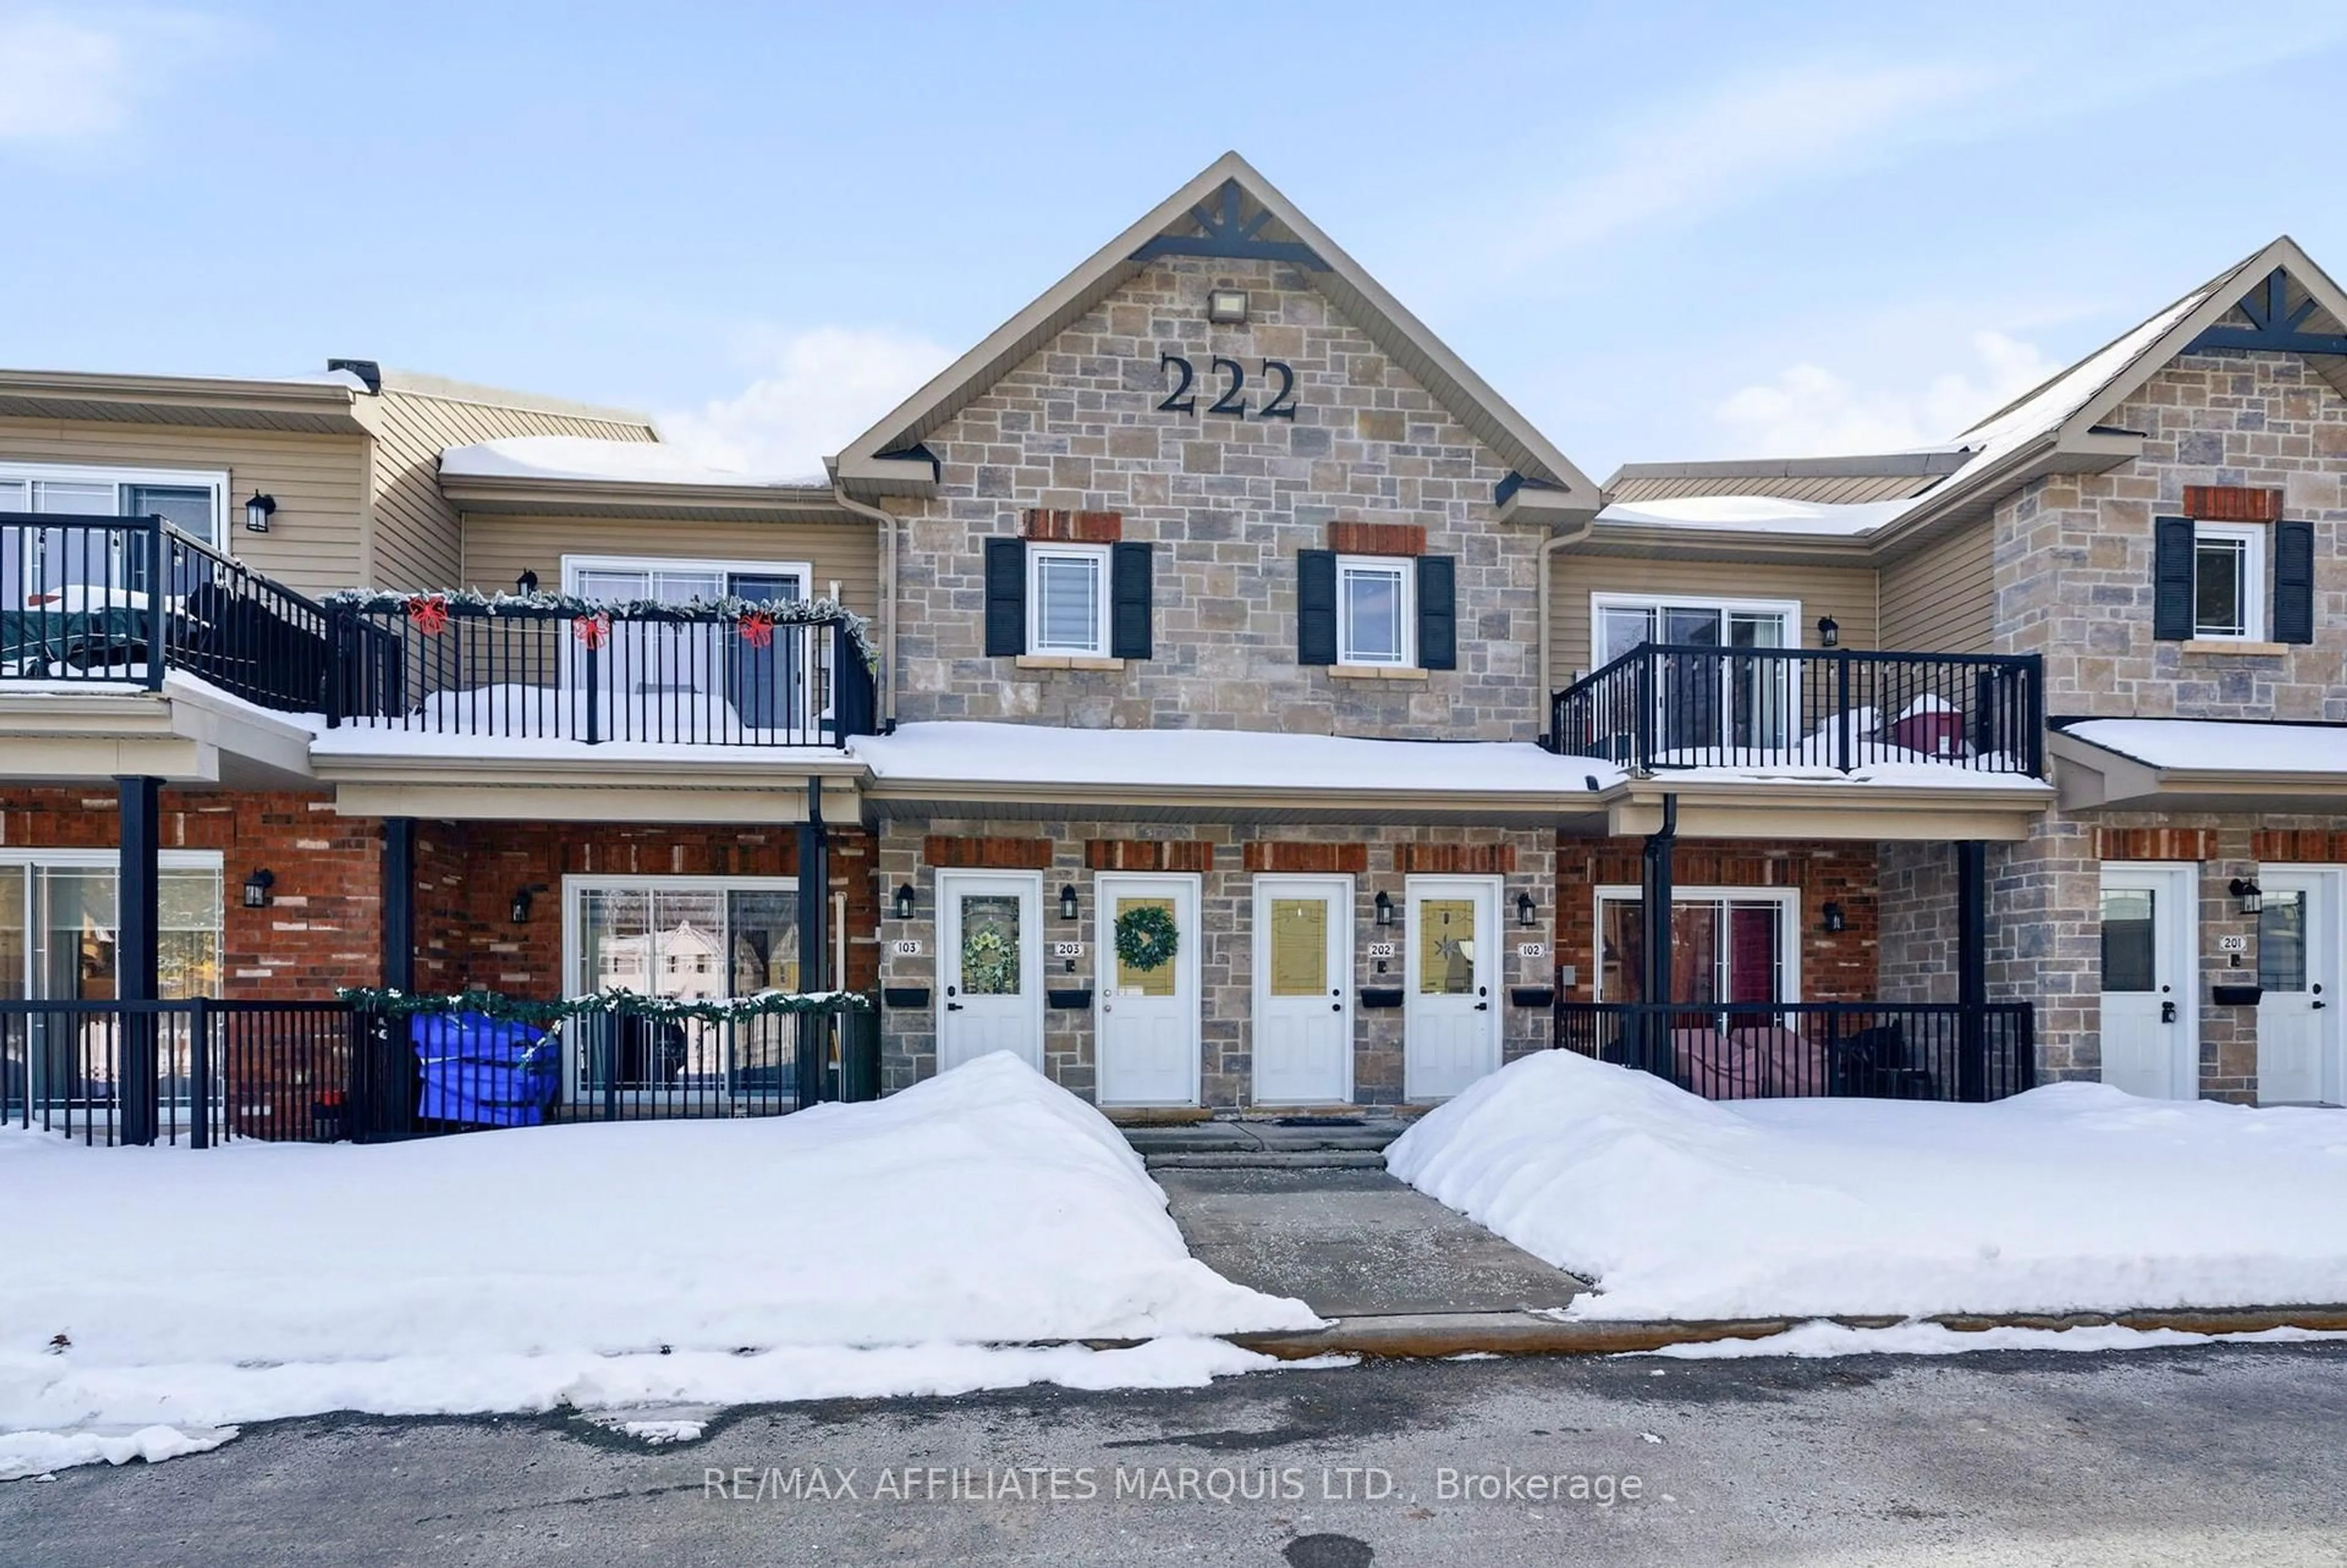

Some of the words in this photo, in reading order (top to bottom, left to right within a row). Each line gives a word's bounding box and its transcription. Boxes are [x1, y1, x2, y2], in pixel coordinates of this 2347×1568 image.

[1158, 352, 1296, 422] 222
[898, 942, 916, 953] 103
[2225, 937, 2241, 948] 201
[1059, 943, 1079, 954] 203
[1372, 945, 1390, 954] 202
[1524, 945, 1540, 954] 102
